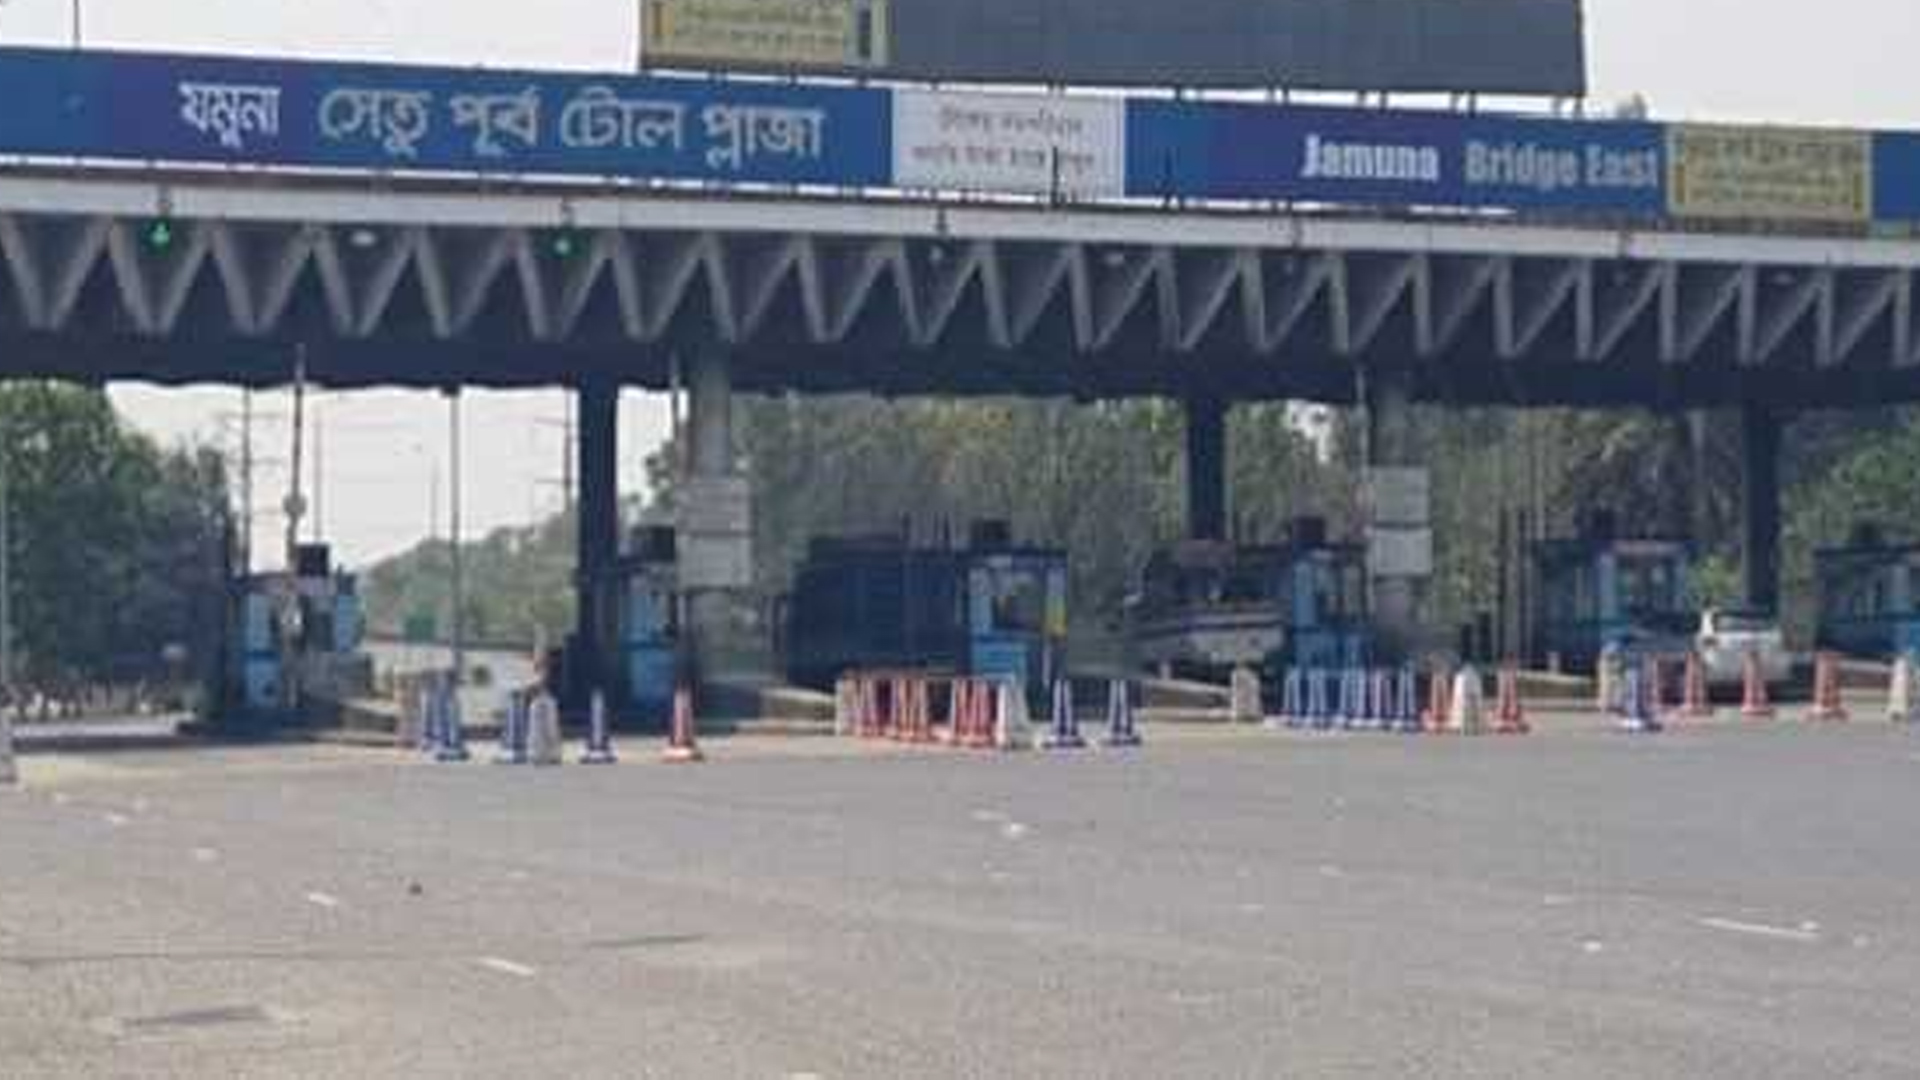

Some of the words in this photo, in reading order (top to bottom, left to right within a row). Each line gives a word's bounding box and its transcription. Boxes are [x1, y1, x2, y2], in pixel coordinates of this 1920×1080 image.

[179, 81, 281, 148] যমুনা
[318, 87, 432, 159] সেতু
[450, 85, 540, 156] পূর্ব
[560, 86, 688, 151] টোল
[701, 103, 826, 170] প্লাজা
[1302, 134, 1440, 182] Jamuna
[1464, 141, 1579, 191] Bridge
[1585, 143, 1659, 188] East
